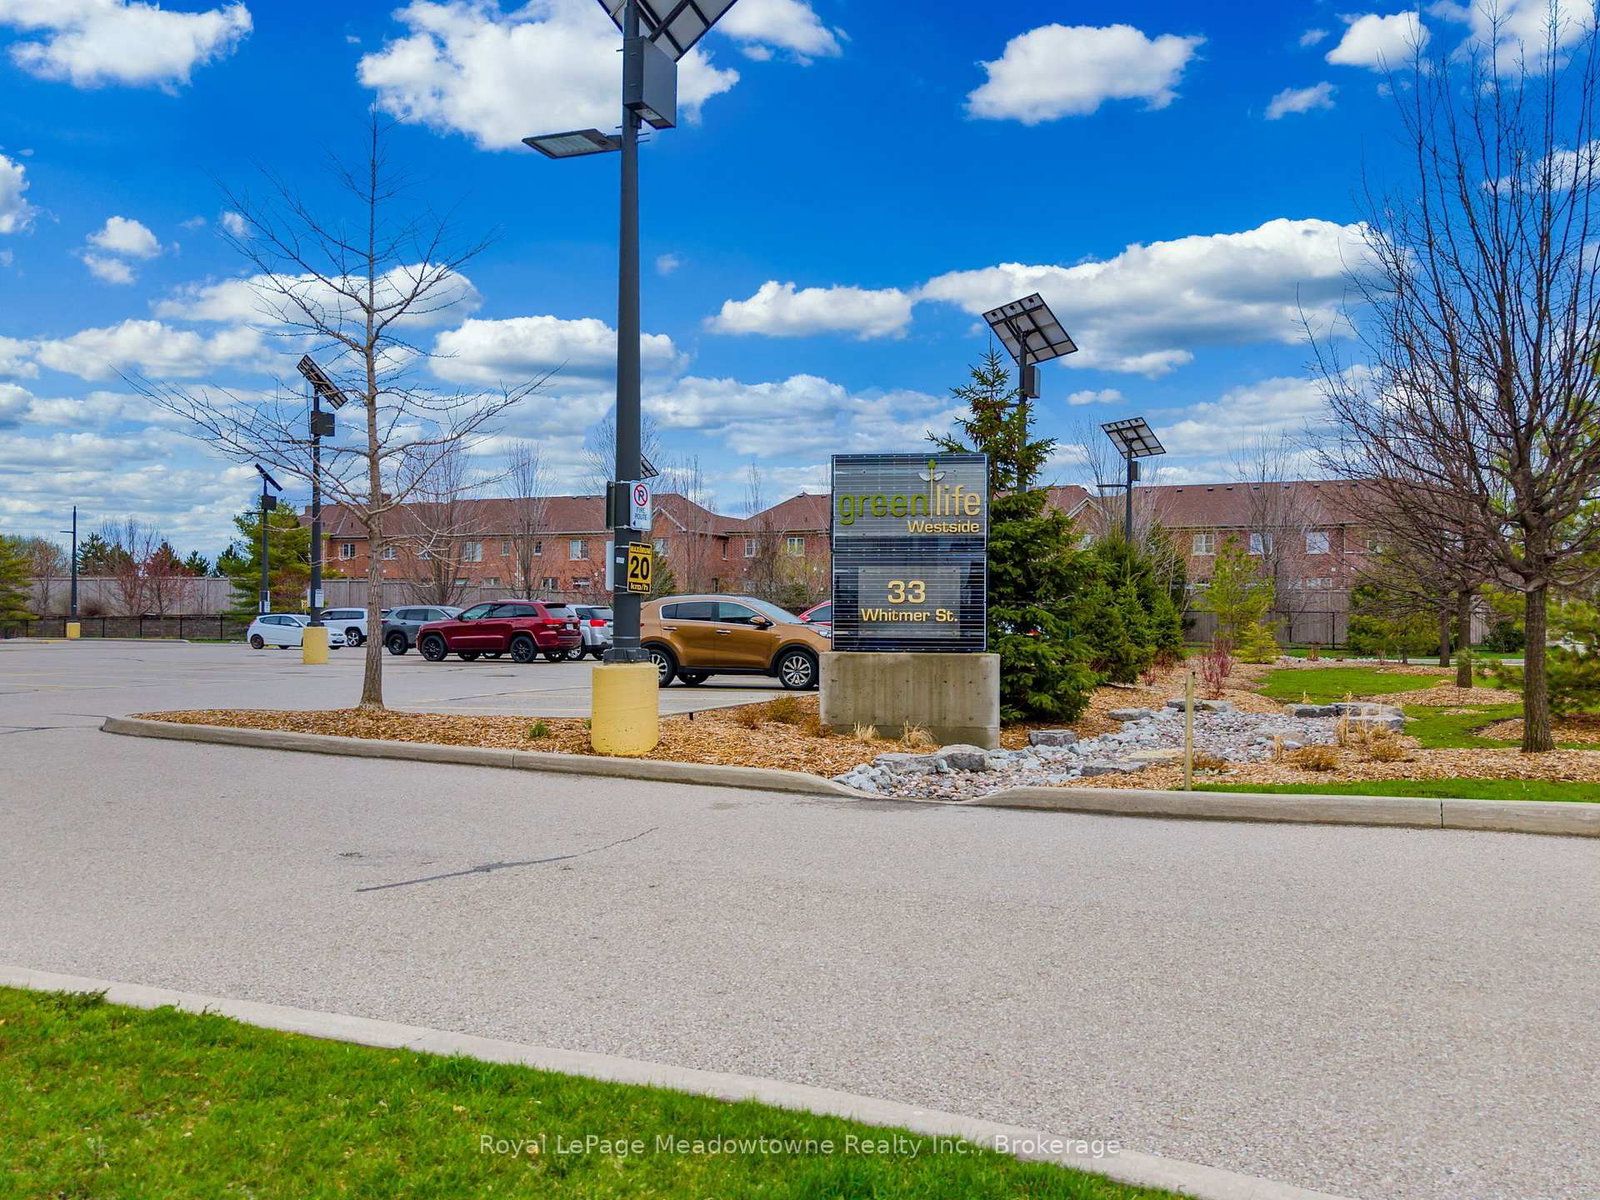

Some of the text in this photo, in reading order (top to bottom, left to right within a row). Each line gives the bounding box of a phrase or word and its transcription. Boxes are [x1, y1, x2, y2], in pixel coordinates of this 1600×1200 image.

[838, 484, 981, 525] green life
[907, 520, 980, 534] Westside
[630, 556, 650, 580] 20
[630, 582, 649, 592] km/h
[887, 580, 926, 604] 33
[861, 608, 959, 622] Whitmer St.
